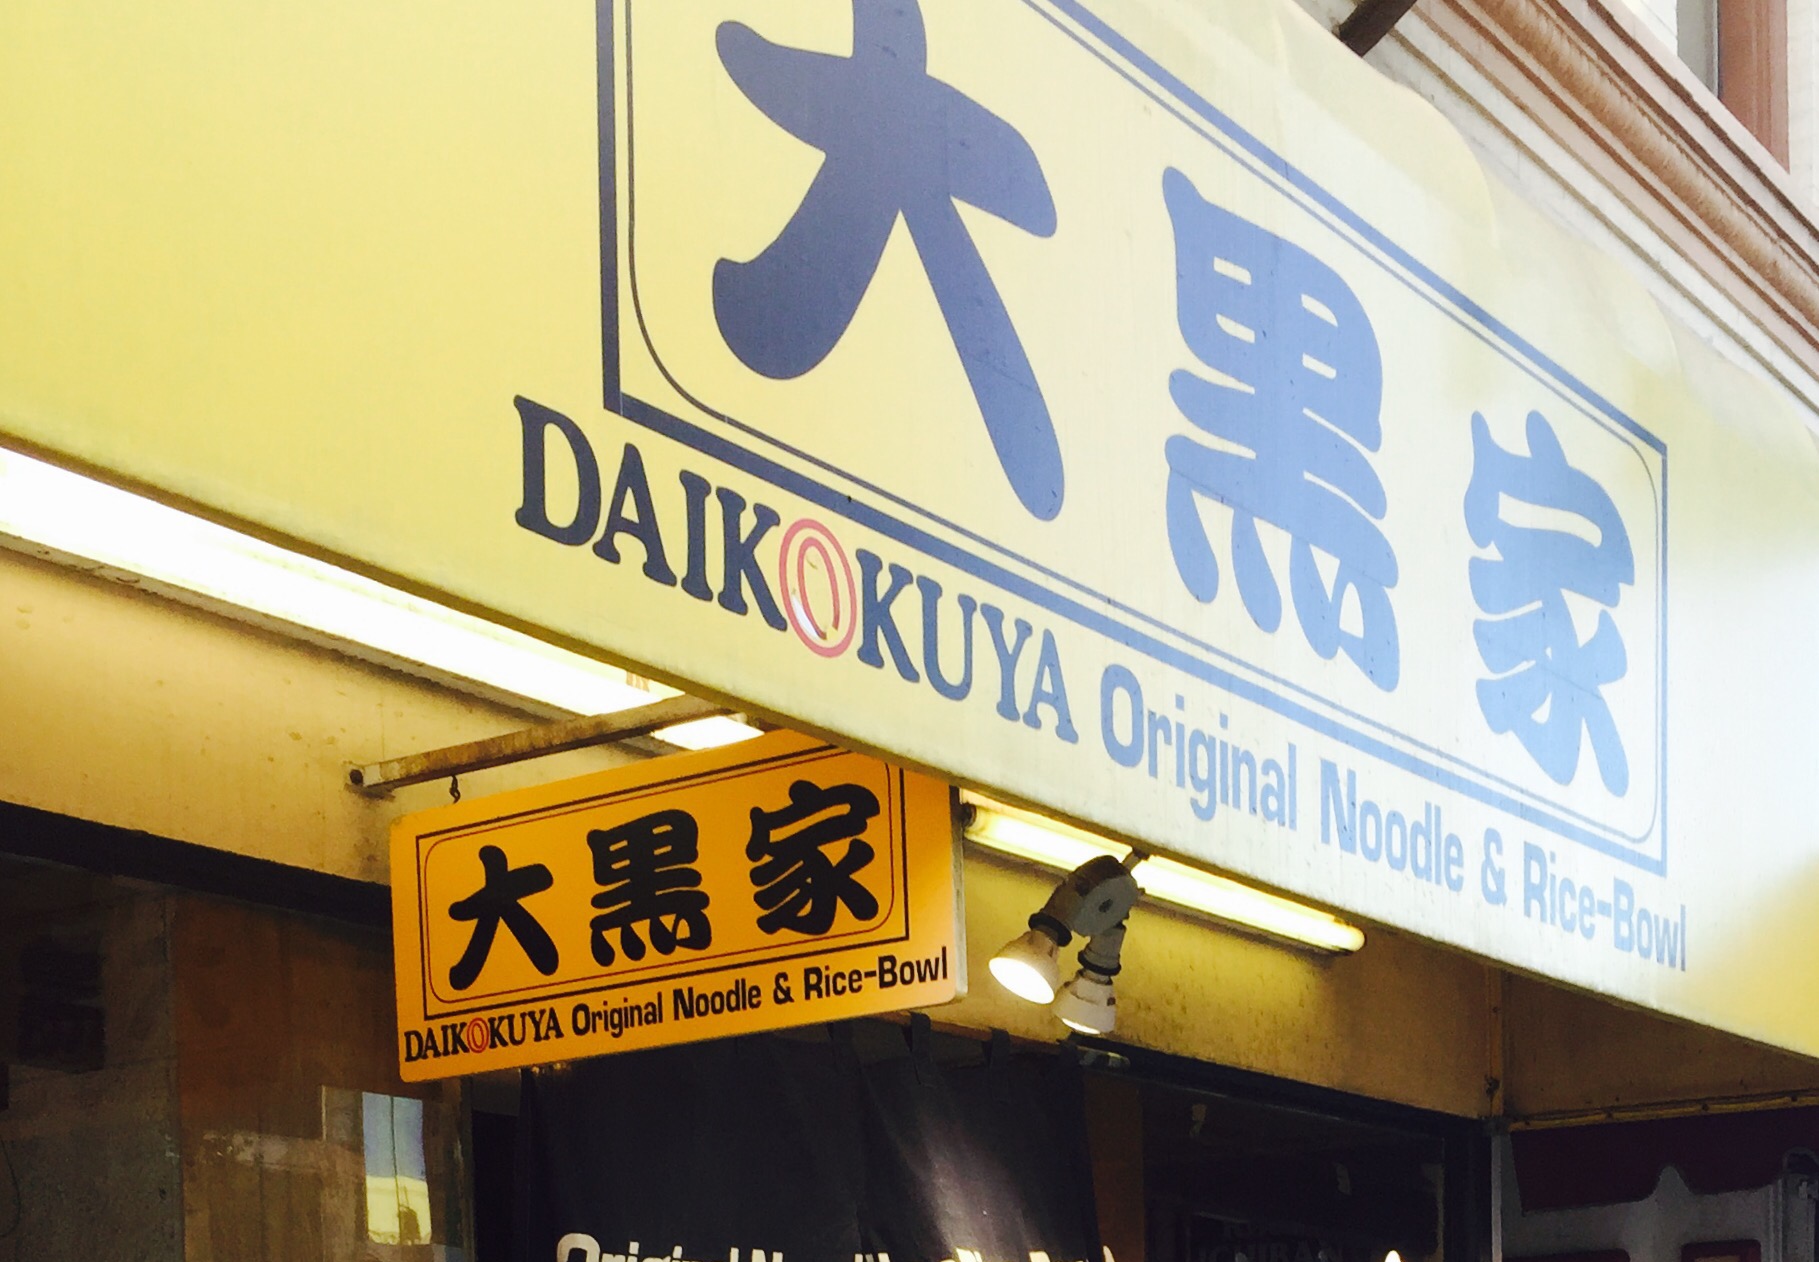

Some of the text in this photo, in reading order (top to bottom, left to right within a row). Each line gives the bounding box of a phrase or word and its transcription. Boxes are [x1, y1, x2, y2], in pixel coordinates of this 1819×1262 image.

[711, 0, 1635, 798] 大黒家
[512, 393, 1687, 972] DAIKOKUYA Original Noodle & Rice-Bowl
[404, 946, 949, 1063] DAIKOKUYA Original Noodle & Rice-Bowl
[448, 779, 881, 992] 大黒家
